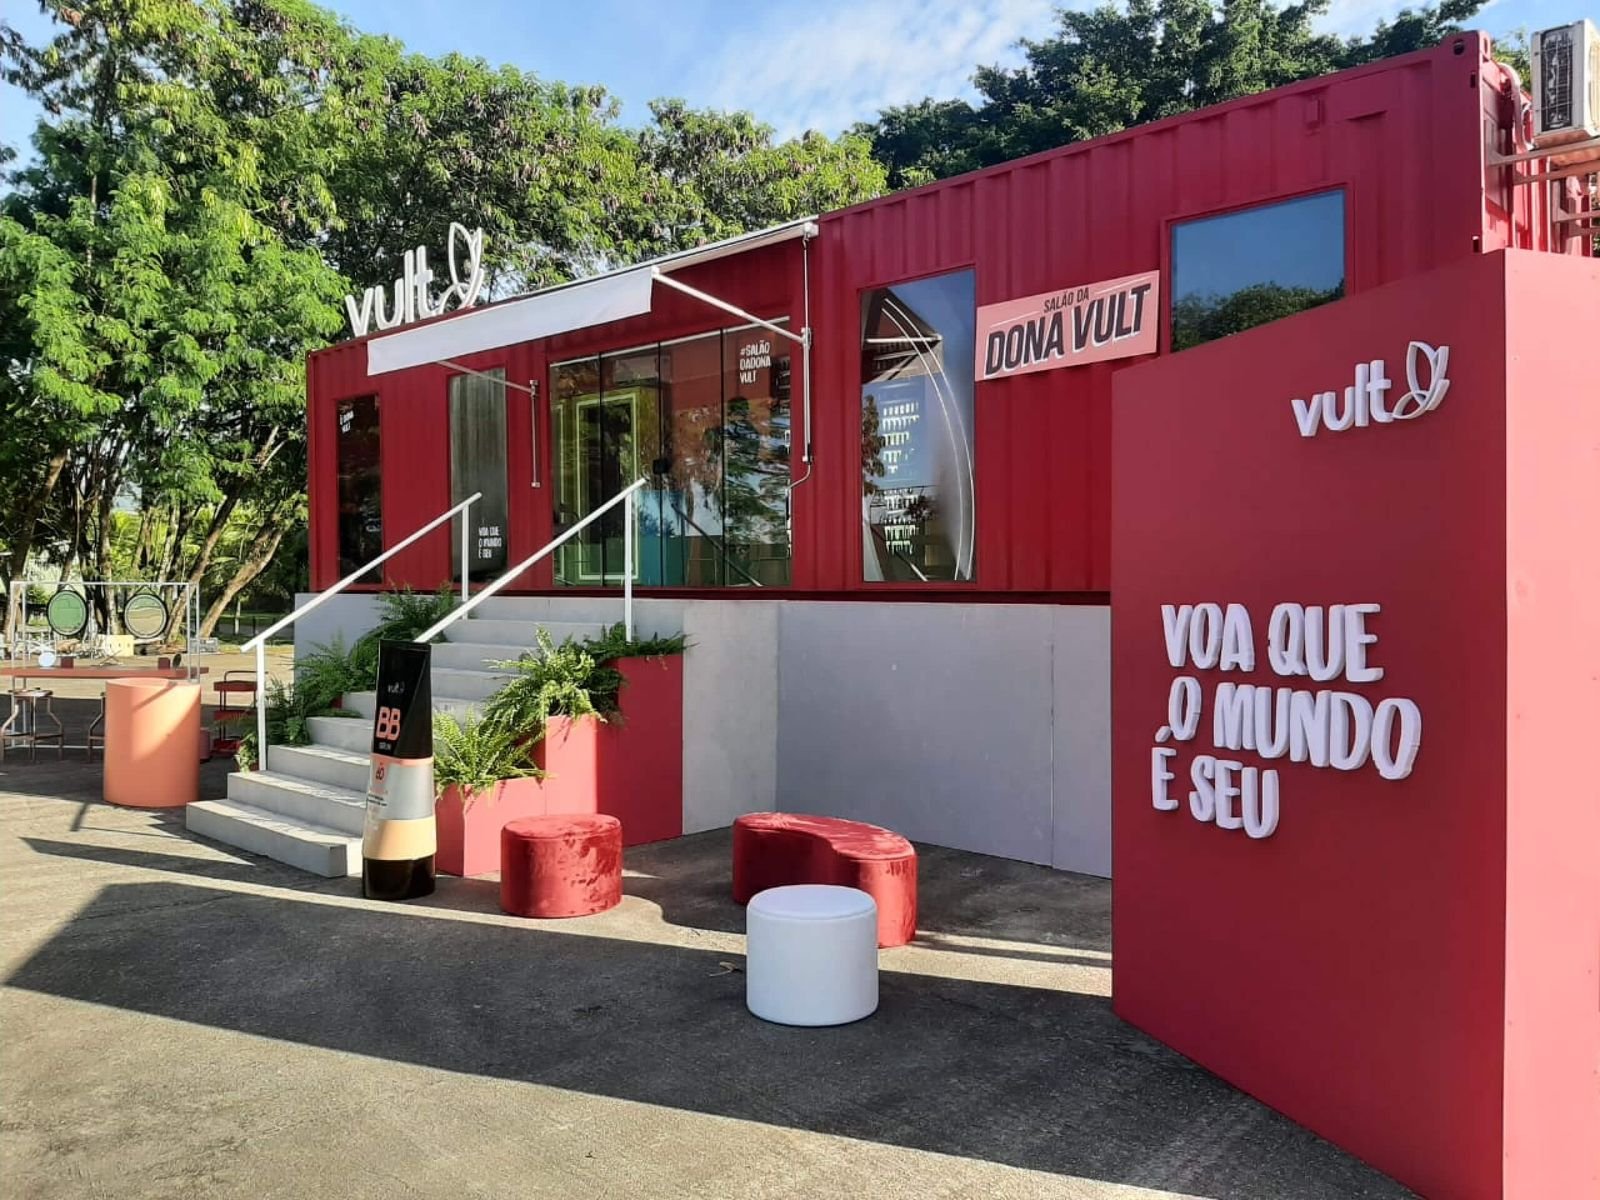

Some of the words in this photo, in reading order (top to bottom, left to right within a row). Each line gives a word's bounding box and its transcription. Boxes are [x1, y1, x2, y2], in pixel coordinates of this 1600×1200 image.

[344, 245, 435, 337] vult
[1043, 289, 1074, 314] SALÃO
[1076, 287, 1090, 302] DA
[740, 339, 770, 356] #SALÃO
[983, 311, 1065, 379] DONA
[1071, 283, 1151, 351] VULT
[739, 370, 756, 384] VULT
[1291, 359, 1395, 437] vult
[1160, 603, 1255, 673] VOA
[1267, 602, 1385, 683] QUE
[375, 706, 401, 741] BB
[1168, 676, 1203, 741] O
[1213, 681, 1423, 781] MUNDO
[1151, 725, 1180, 811] É
[1188, 754, 1280, 839] SEU
